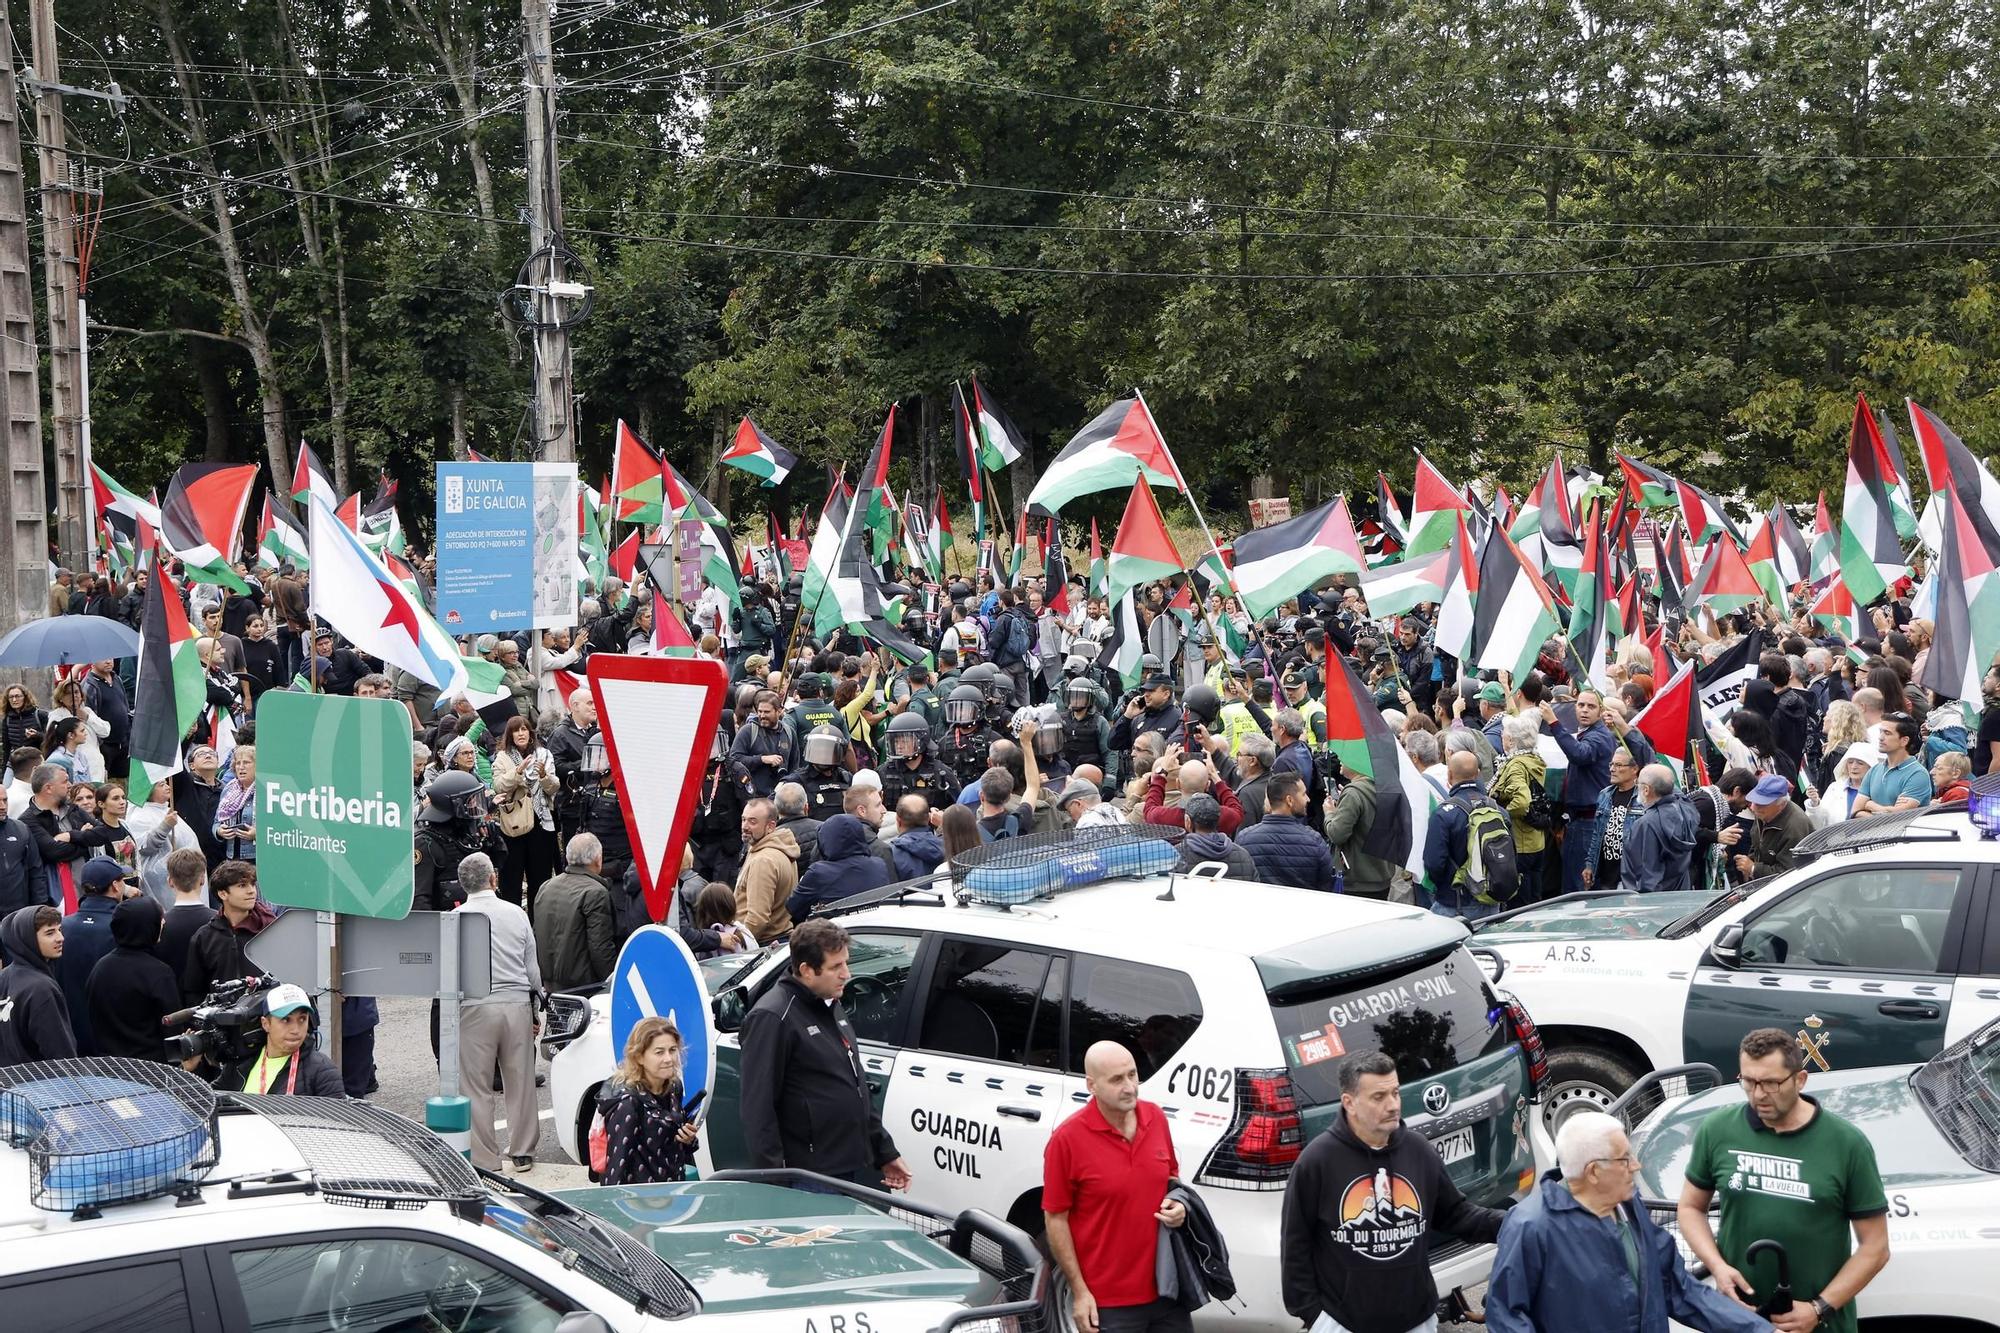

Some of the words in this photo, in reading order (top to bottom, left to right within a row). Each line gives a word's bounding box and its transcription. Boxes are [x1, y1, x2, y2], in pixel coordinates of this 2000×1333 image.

[466, 479, 505, 493] XUNTA
[466, 497, 481, 510] DE
[483, 495, 527, 510] GALICIA
[478, 530, 485, 538] DE
[805, 712, 835, 720] GUARDIA
[266, 781, 401, 828] Fertiberia
[266, 826, 347, 854] Fertilizantes
[1545, 945, 1596, 963] A.R.S.
[1329, 986, 1415, 1028] GUARDIA
[1414, 974, 1456, 1001] CIVIL
[1303, 1038, 1331, 1063] 2905
[1187, 1064, 1233, 1104] 062
[911, 1107, 1003, 1152] GUARDIA
[933, 1145, 982, 1180] CIVIL
[1736, 1154, 1801, 1181] SPRINTER
[1747, 1174, 1759, 1187] DE
[1776, 1179, 1806, 1194] VUELTA
[1330, 1230, 1351, 1244] COL
[1354, 1229, 1369, 1244] DU
[1371, 1219, 1427, 1243] TOURMALET
[1372, 1243, 1388, 1253] 2115
[1389, 1243, 1396, 1251] M
